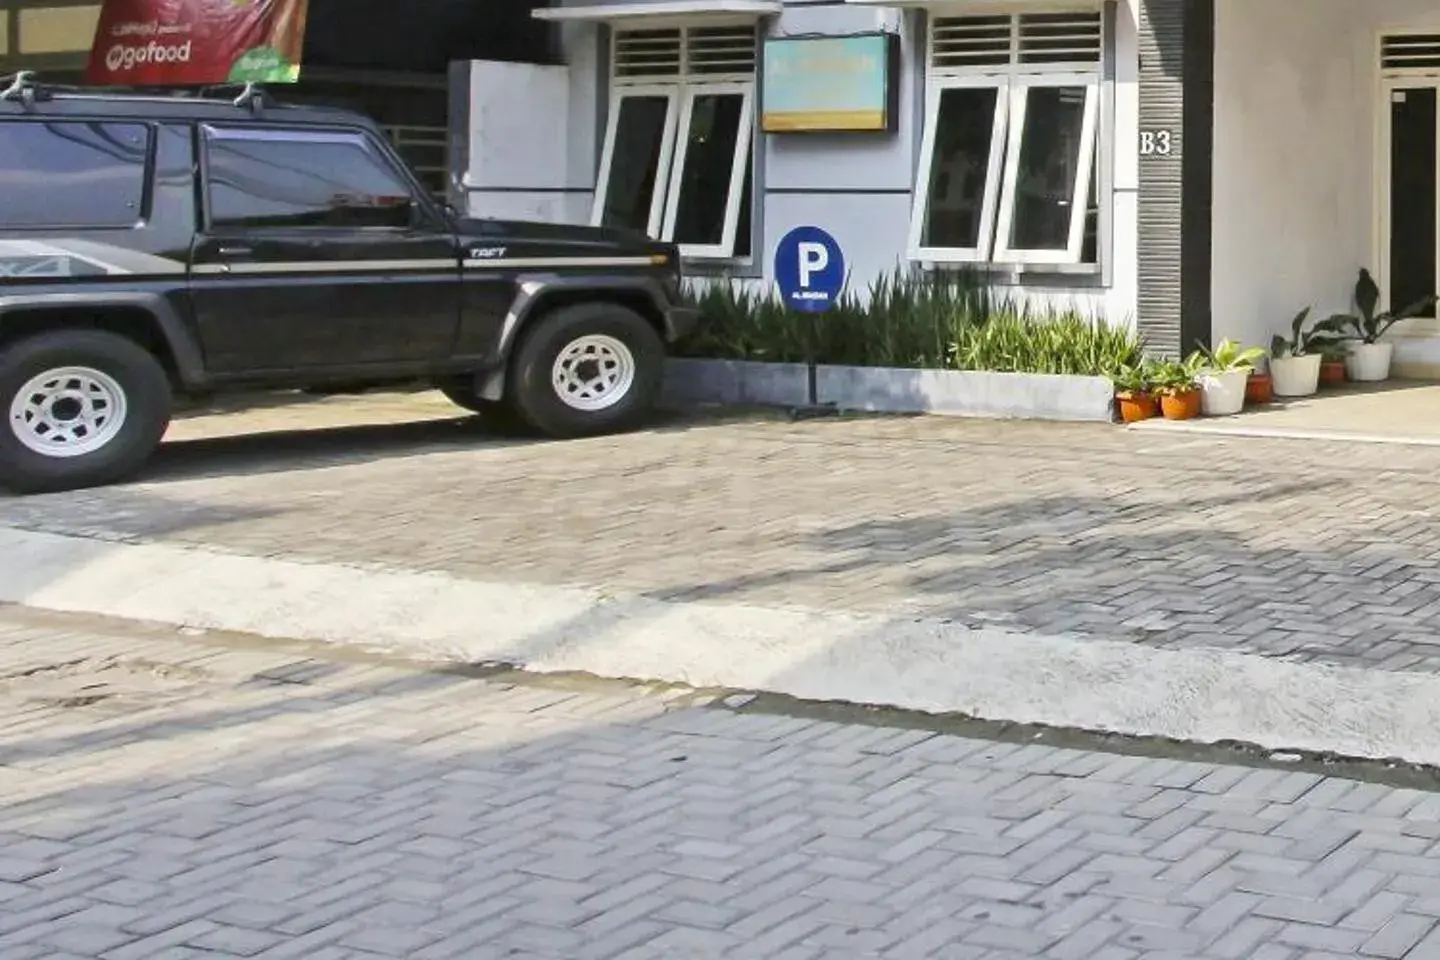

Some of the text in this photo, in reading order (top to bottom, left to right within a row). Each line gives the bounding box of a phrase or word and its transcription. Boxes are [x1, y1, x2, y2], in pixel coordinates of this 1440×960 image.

[125, 40, 192, 70] gofood
[1140, 130, 1171, 155] B3
[798, 242, 829, 287] P
